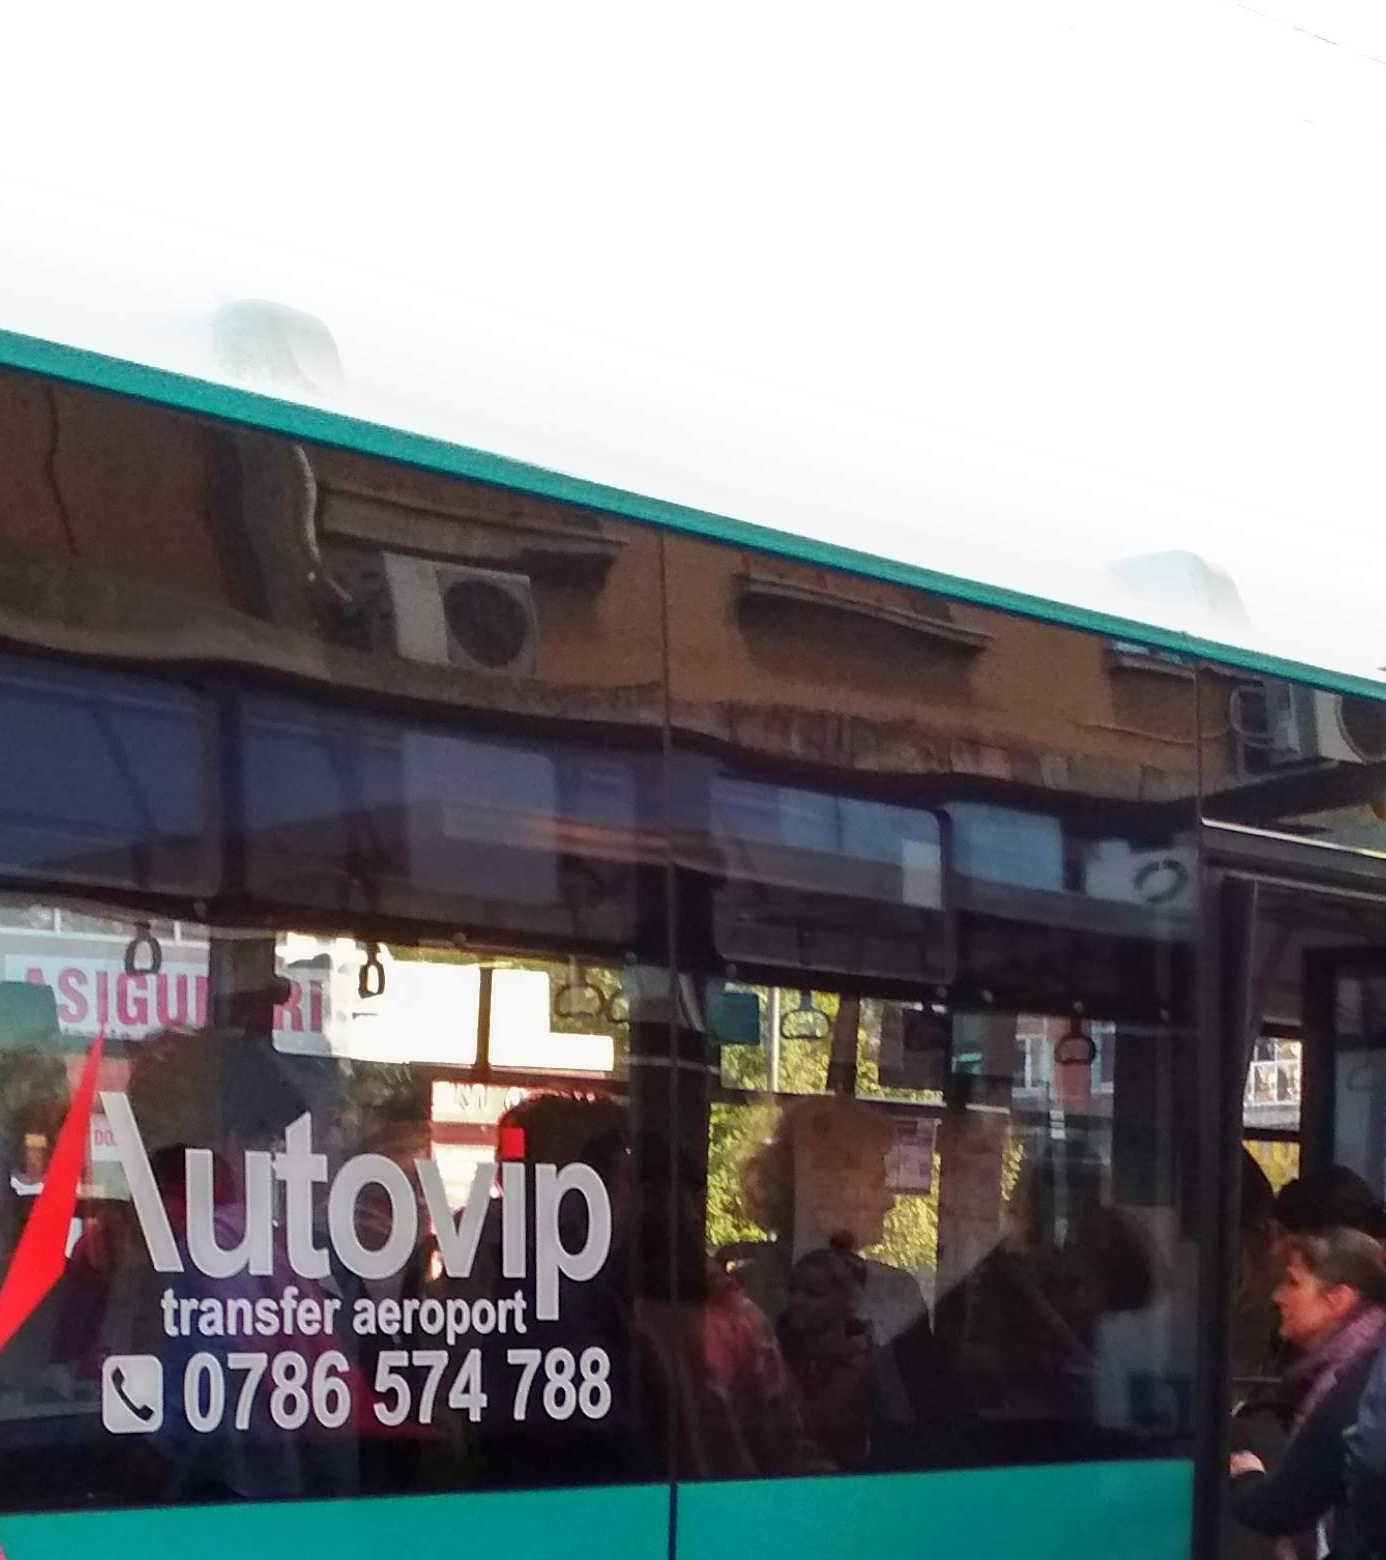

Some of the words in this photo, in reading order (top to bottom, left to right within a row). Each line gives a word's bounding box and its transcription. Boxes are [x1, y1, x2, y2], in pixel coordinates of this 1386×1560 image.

[161, 1285, 341, 1337] transfer
[353, 1289, 528, 1346] aeroport
[183, 1349, 352, 1433] 0786
[373, 1347, 489, 1427] 574
[507, 1346, 612, 1422] 788
